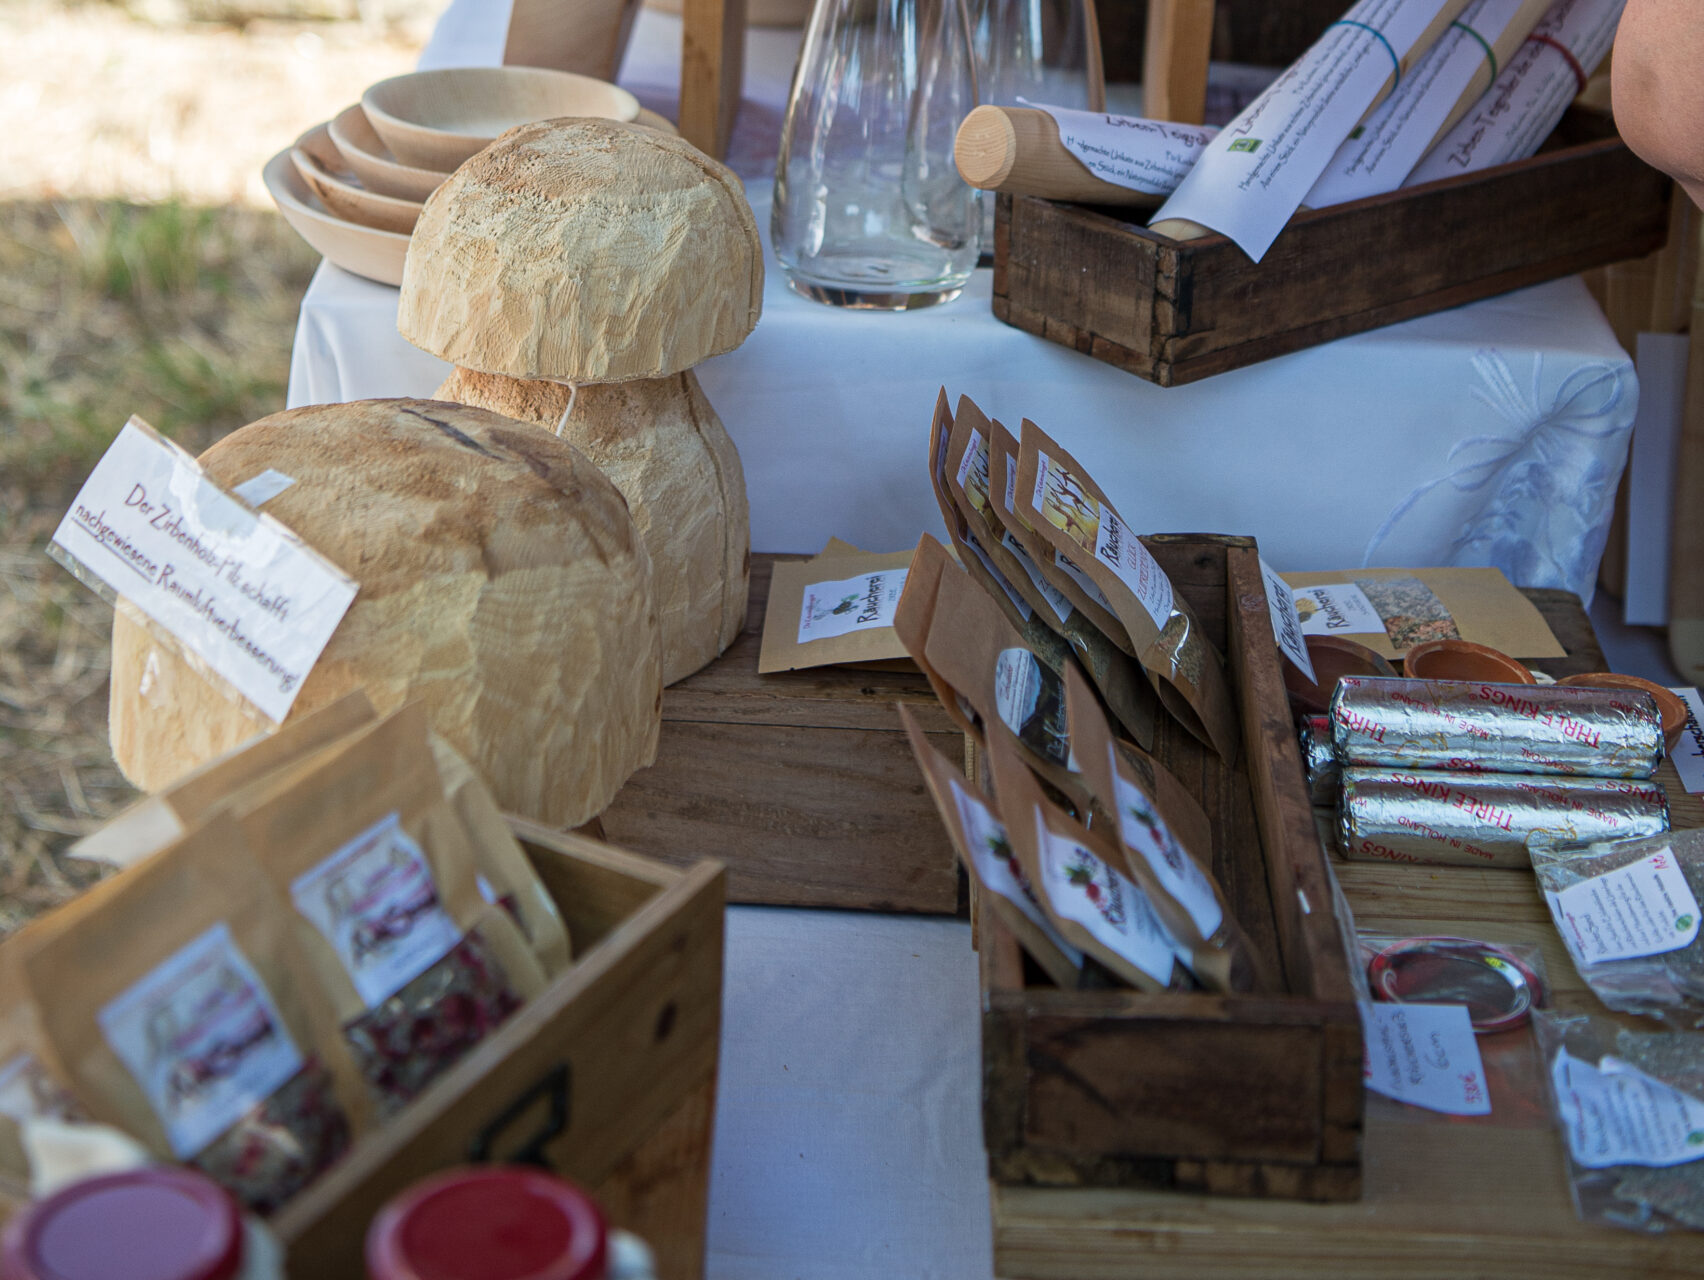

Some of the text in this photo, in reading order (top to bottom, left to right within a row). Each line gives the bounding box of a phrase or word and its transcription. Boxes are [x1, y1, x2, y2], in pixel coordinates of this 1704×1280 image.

[75, 503, 158, 577] nachgewiesene
[124, 483, 154, 515] Der
[240, 583, 289, 622] schafft
[1100, 511, 1121, 568] Räucherei
[857, 575, 881, 624] Räucherei
[1307, 589, 1350, 629] Räucherei
[1444, 713, 1455, 724] IN
[1459, 720, 1490, 740] MADE
[1521, 747, 1575, 773] CHARCOAL
[1453, 791, 1512, 832] THREE
[1516, 782, 1619, 827] MADE IN HOLLAND
[1398, 815, 1495, 860] MADE IN HOLLAND
